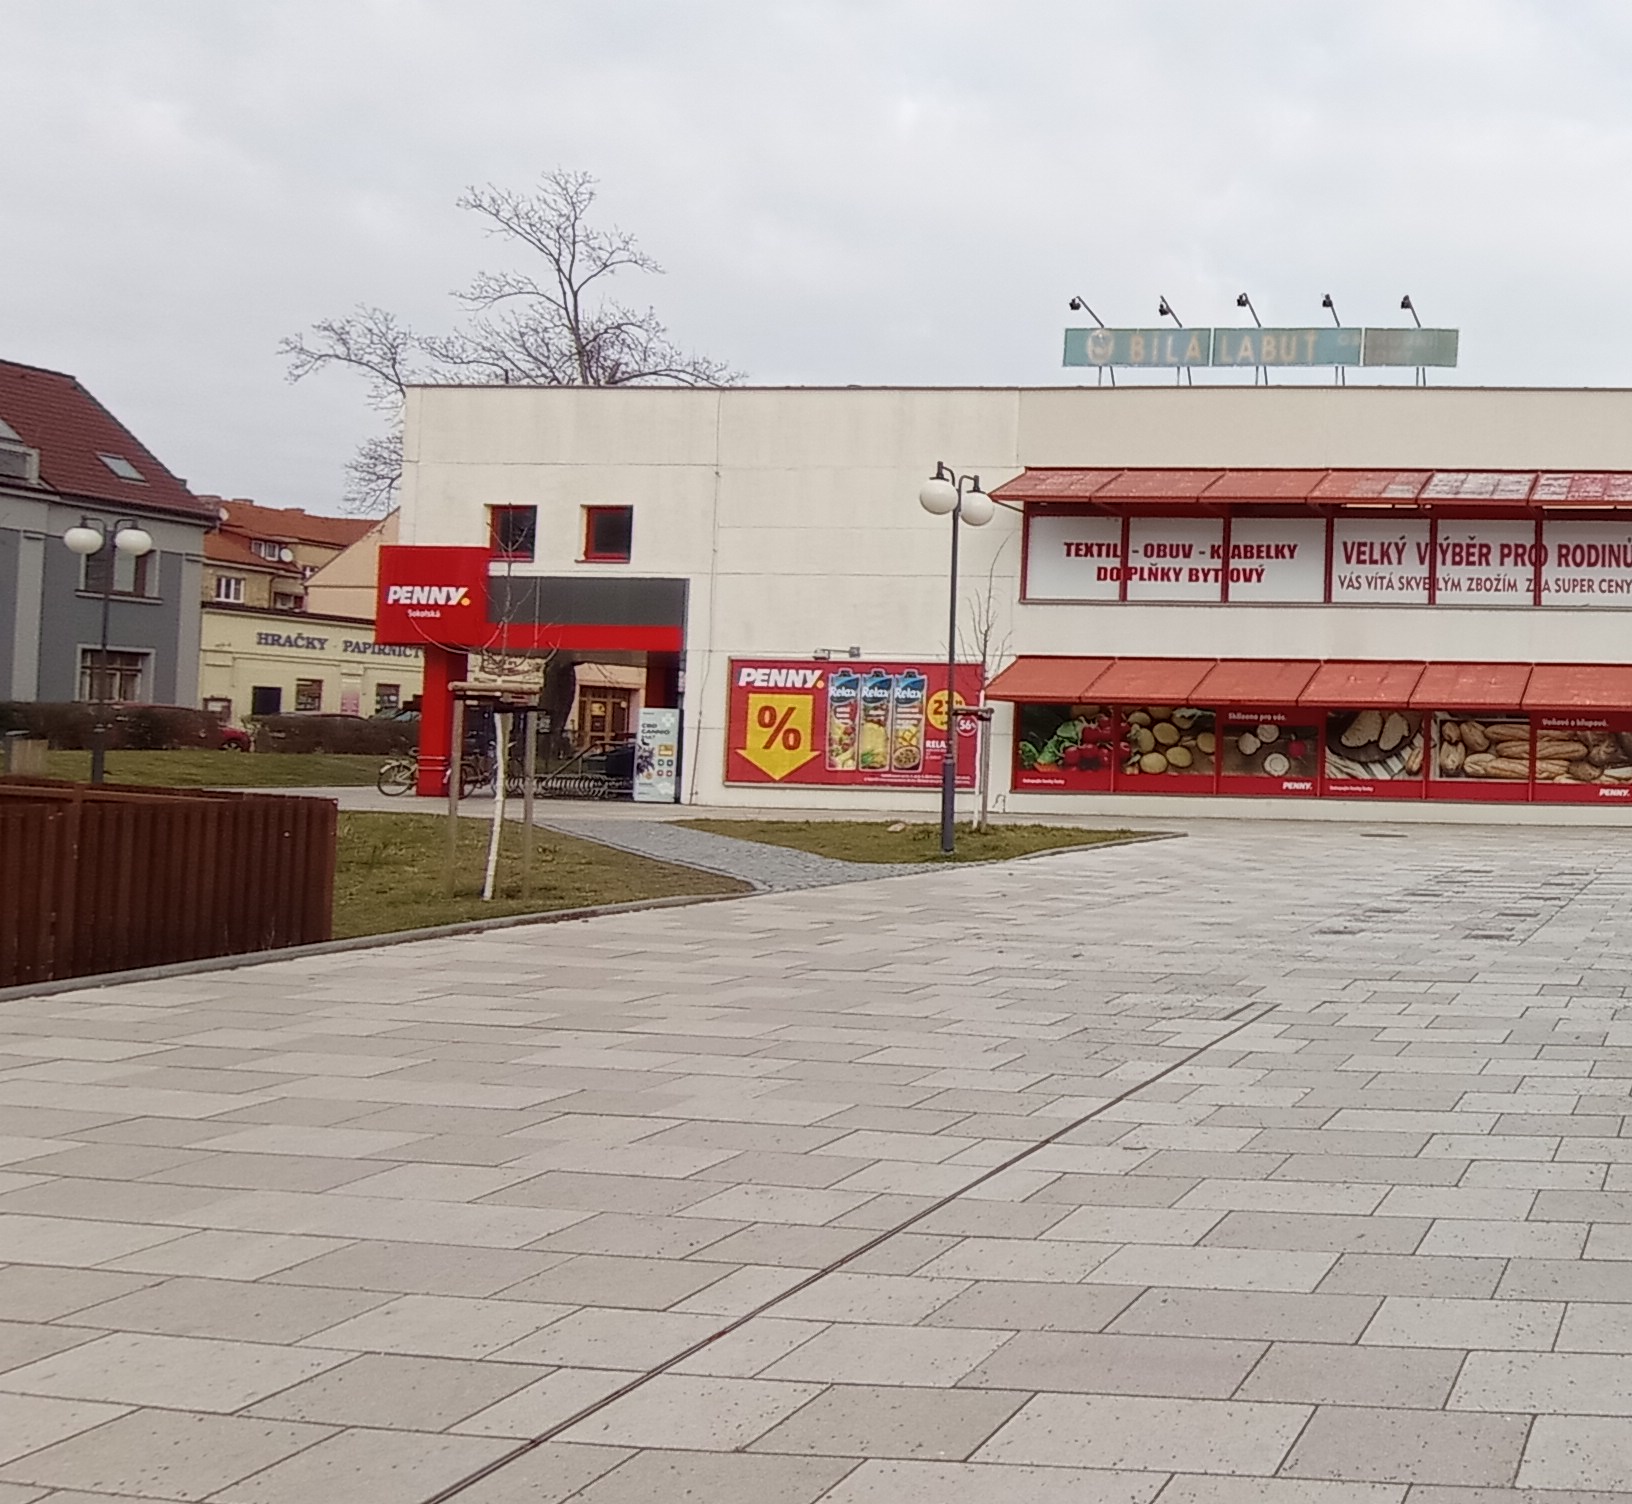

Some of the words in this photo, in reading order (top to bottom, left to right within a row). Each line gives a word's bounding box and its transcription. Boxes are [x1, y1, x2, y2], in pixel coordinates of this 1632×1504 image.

[1064, 542, 1121, 558] TEXTIL
[1143, 543, 1194, 559] OBUV
[1210, 544, 1298, 560] KABELKY
[1342, 536, 1407, 565] VELKÝ
[1416, 536, 1492, 567] VÝBĚR
[1500, 543, 1549, 567] PRO
[1097, 562, 1183, 582] DOPLŇKY
[1188, 564, 1265, 583] BYTOVÝ
[1338, 571, 1362, 590] VÁS
[1365, 572, 1395, 591] VÍTÁ
[1467, 573, 1518, 593] ZBOŽÍM
[1554, 578, 1595, 594] SUPER
[256, 632, 329, 651] HRAČKY
